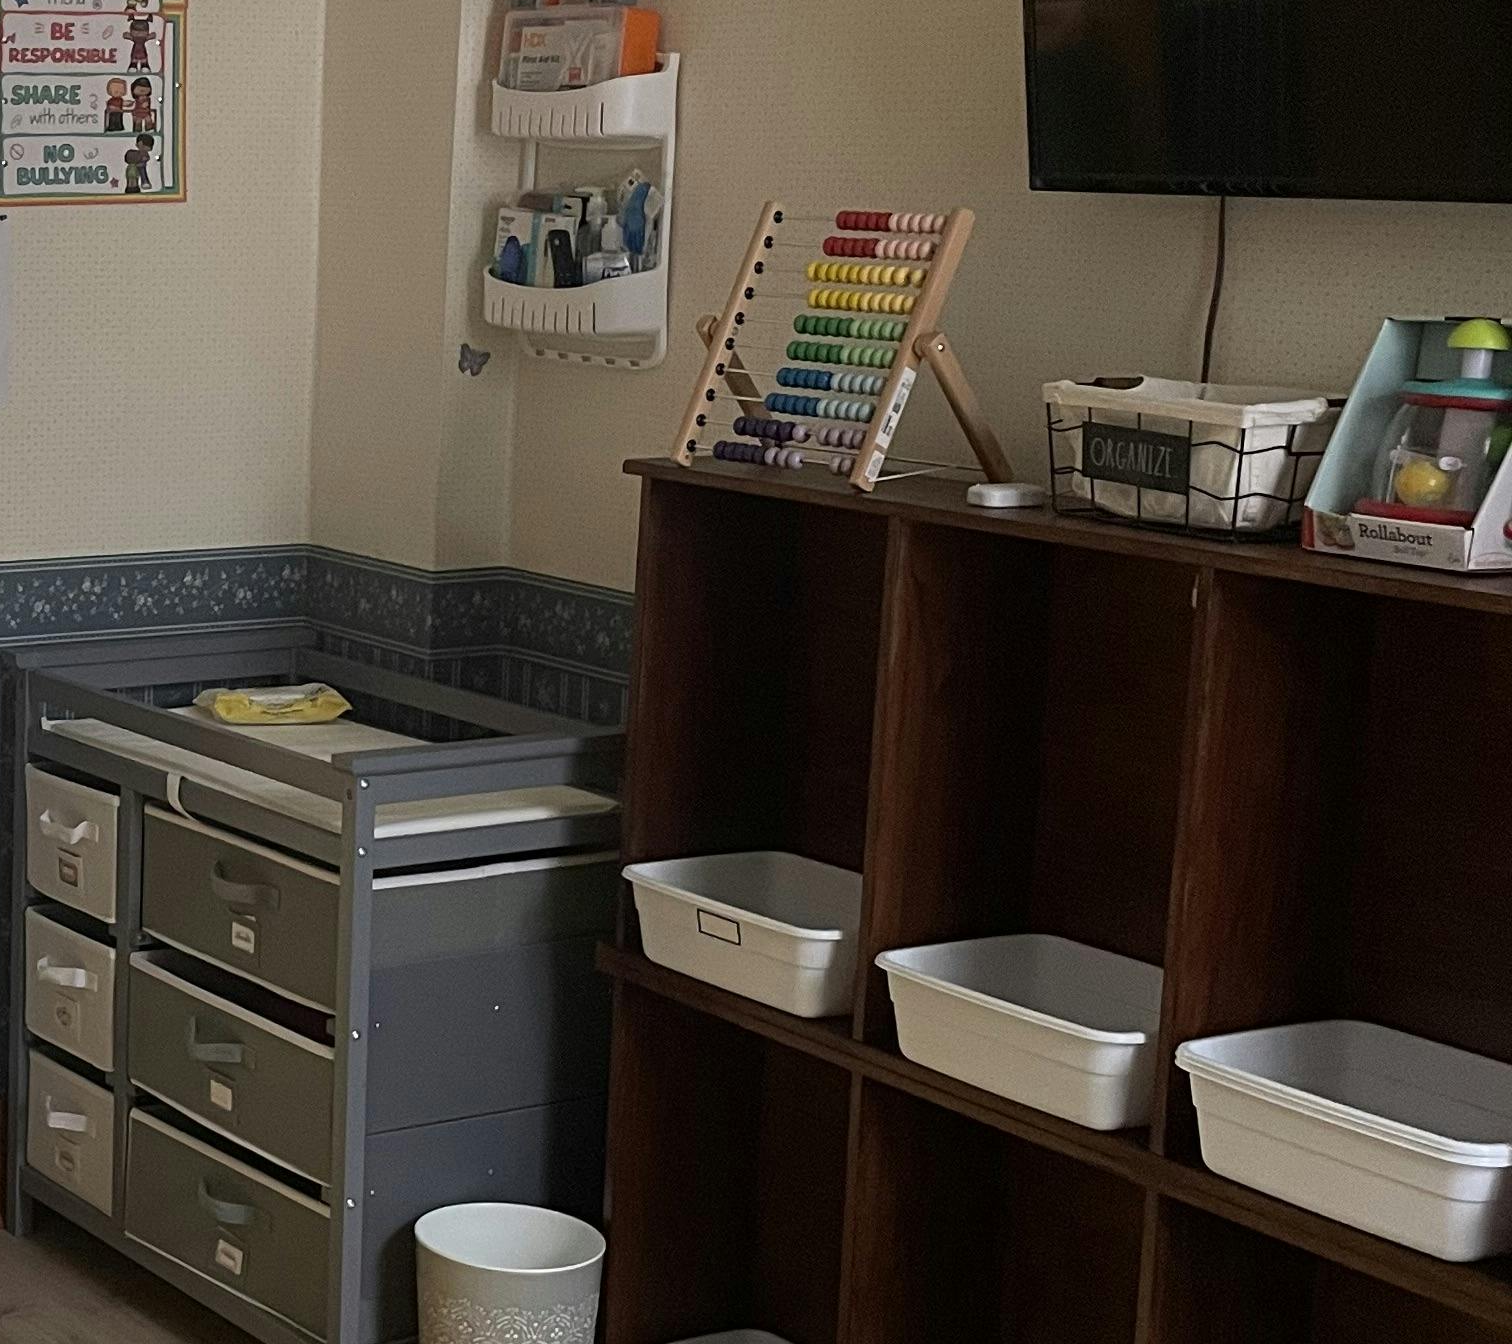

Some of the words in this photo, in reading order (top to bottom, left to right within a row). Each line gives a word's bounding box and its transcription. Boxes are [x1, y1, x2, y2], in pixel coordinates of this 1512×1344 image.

[50, 22, 75, 41] BE
[8, 47, 117, 64] RESPONSIBLE
[11, 84, 82, 105] SHARE
[29, 107, 56, 125] with
[58, 108, 99, 125] others
[43, 143, 75, 163] NO
[17, 165, 109, 186] BULLYING
[1358, 523, 1433, 546] Rollabout
